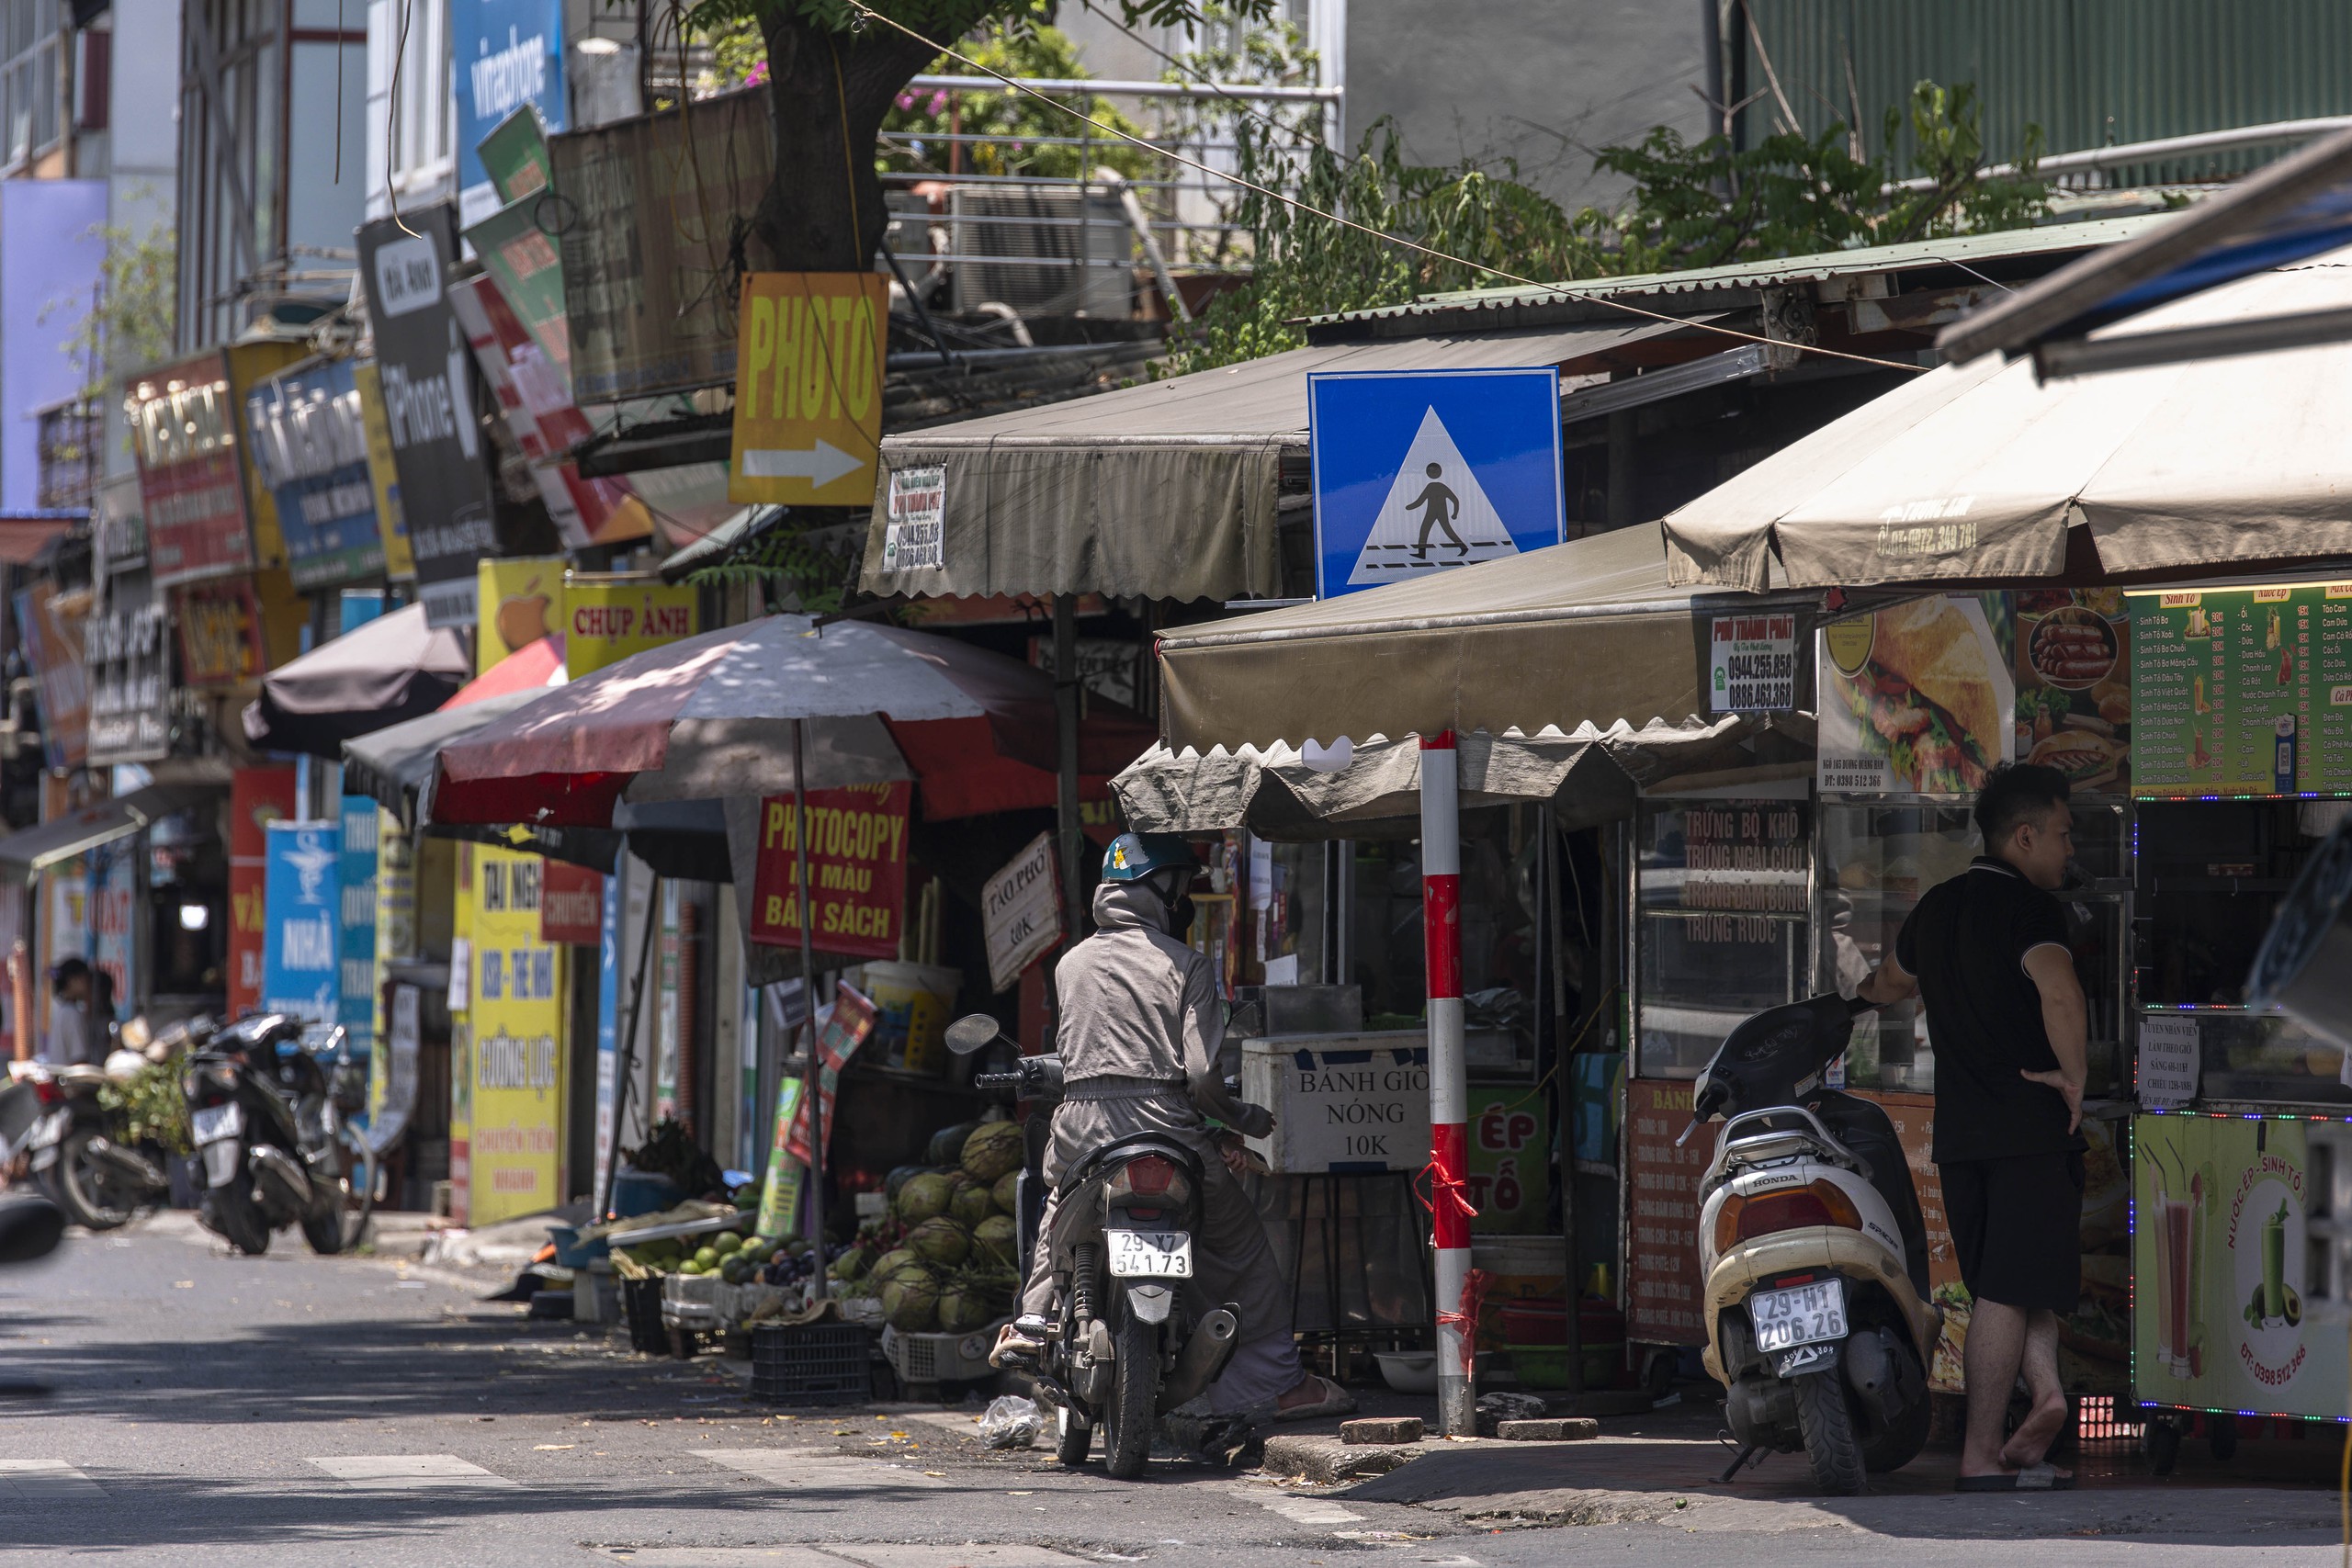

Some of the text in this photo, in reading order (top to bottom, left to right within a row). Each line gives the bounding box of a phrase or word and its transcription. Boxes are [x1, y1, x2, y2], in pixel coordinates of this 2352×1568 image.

[471, 24, 545, 119] vinaphone
[746, 295, 876, 421] PHOTO
[573, 592, 692, 647] CHỤP ẢNH
[2140, 616, 2152, 626] Sinh
[2334, 604, 2347, 613] Cam
[1714, 614, 1794, 642] PHÚ THÀNH PHÁT
[2140, 631, 2153, 640] Sinh
[2140, 645, 2153, 654] Sinh
[1728, 653, 1792, 681] 0944.255.858
[2140, 660, 2153, 669] Sinh
[1729, 682, 1792, 709] 0886.463.368
[1837, 774, 1853, 787] 0398
[1854, 774, 1868, 787] 512
[1869, 774, 1882, 787] 366
[1685, 806, 1735, 840] TRỨNG
[1685, 839, 1731, 872] TRỨNG
[821, 862, 873, 894] MÀU
[822, 897, 891, 939] SÁCH
[282, 909, 334, 972] NHÀ
[1299, 1065, 1430, 1093] BÁNH GIÒ
[1325, 1098, 1405, 1124] NÓNG
[1479, 1103, 1537, 1151] ÉP
[1346, 1135, 1390, 1156] 10K
[1467, 1157, 1522, 1213] TỐ
[1752, 1174, 1799, 1188] HONDA
[2242, 1168, 2254, 1191] ÉP
[2261, 1156, 2287, 1176] SINH
[2288, 1164, 2304, 1191] TỐ
[1122, 1234, 1177, 1253] 29-X7
[1117, 1254, 1187, 1274] 541.73
[1765, 1284, 1829, 1319] 29-H1
[1761, 1310, 1841, 1348] 206.26
[2254, 1361, 2276, 1386] 0398
[2277, 1363, 2291, 1385] 512
[2290, 1343, 2306, 1374] 366
